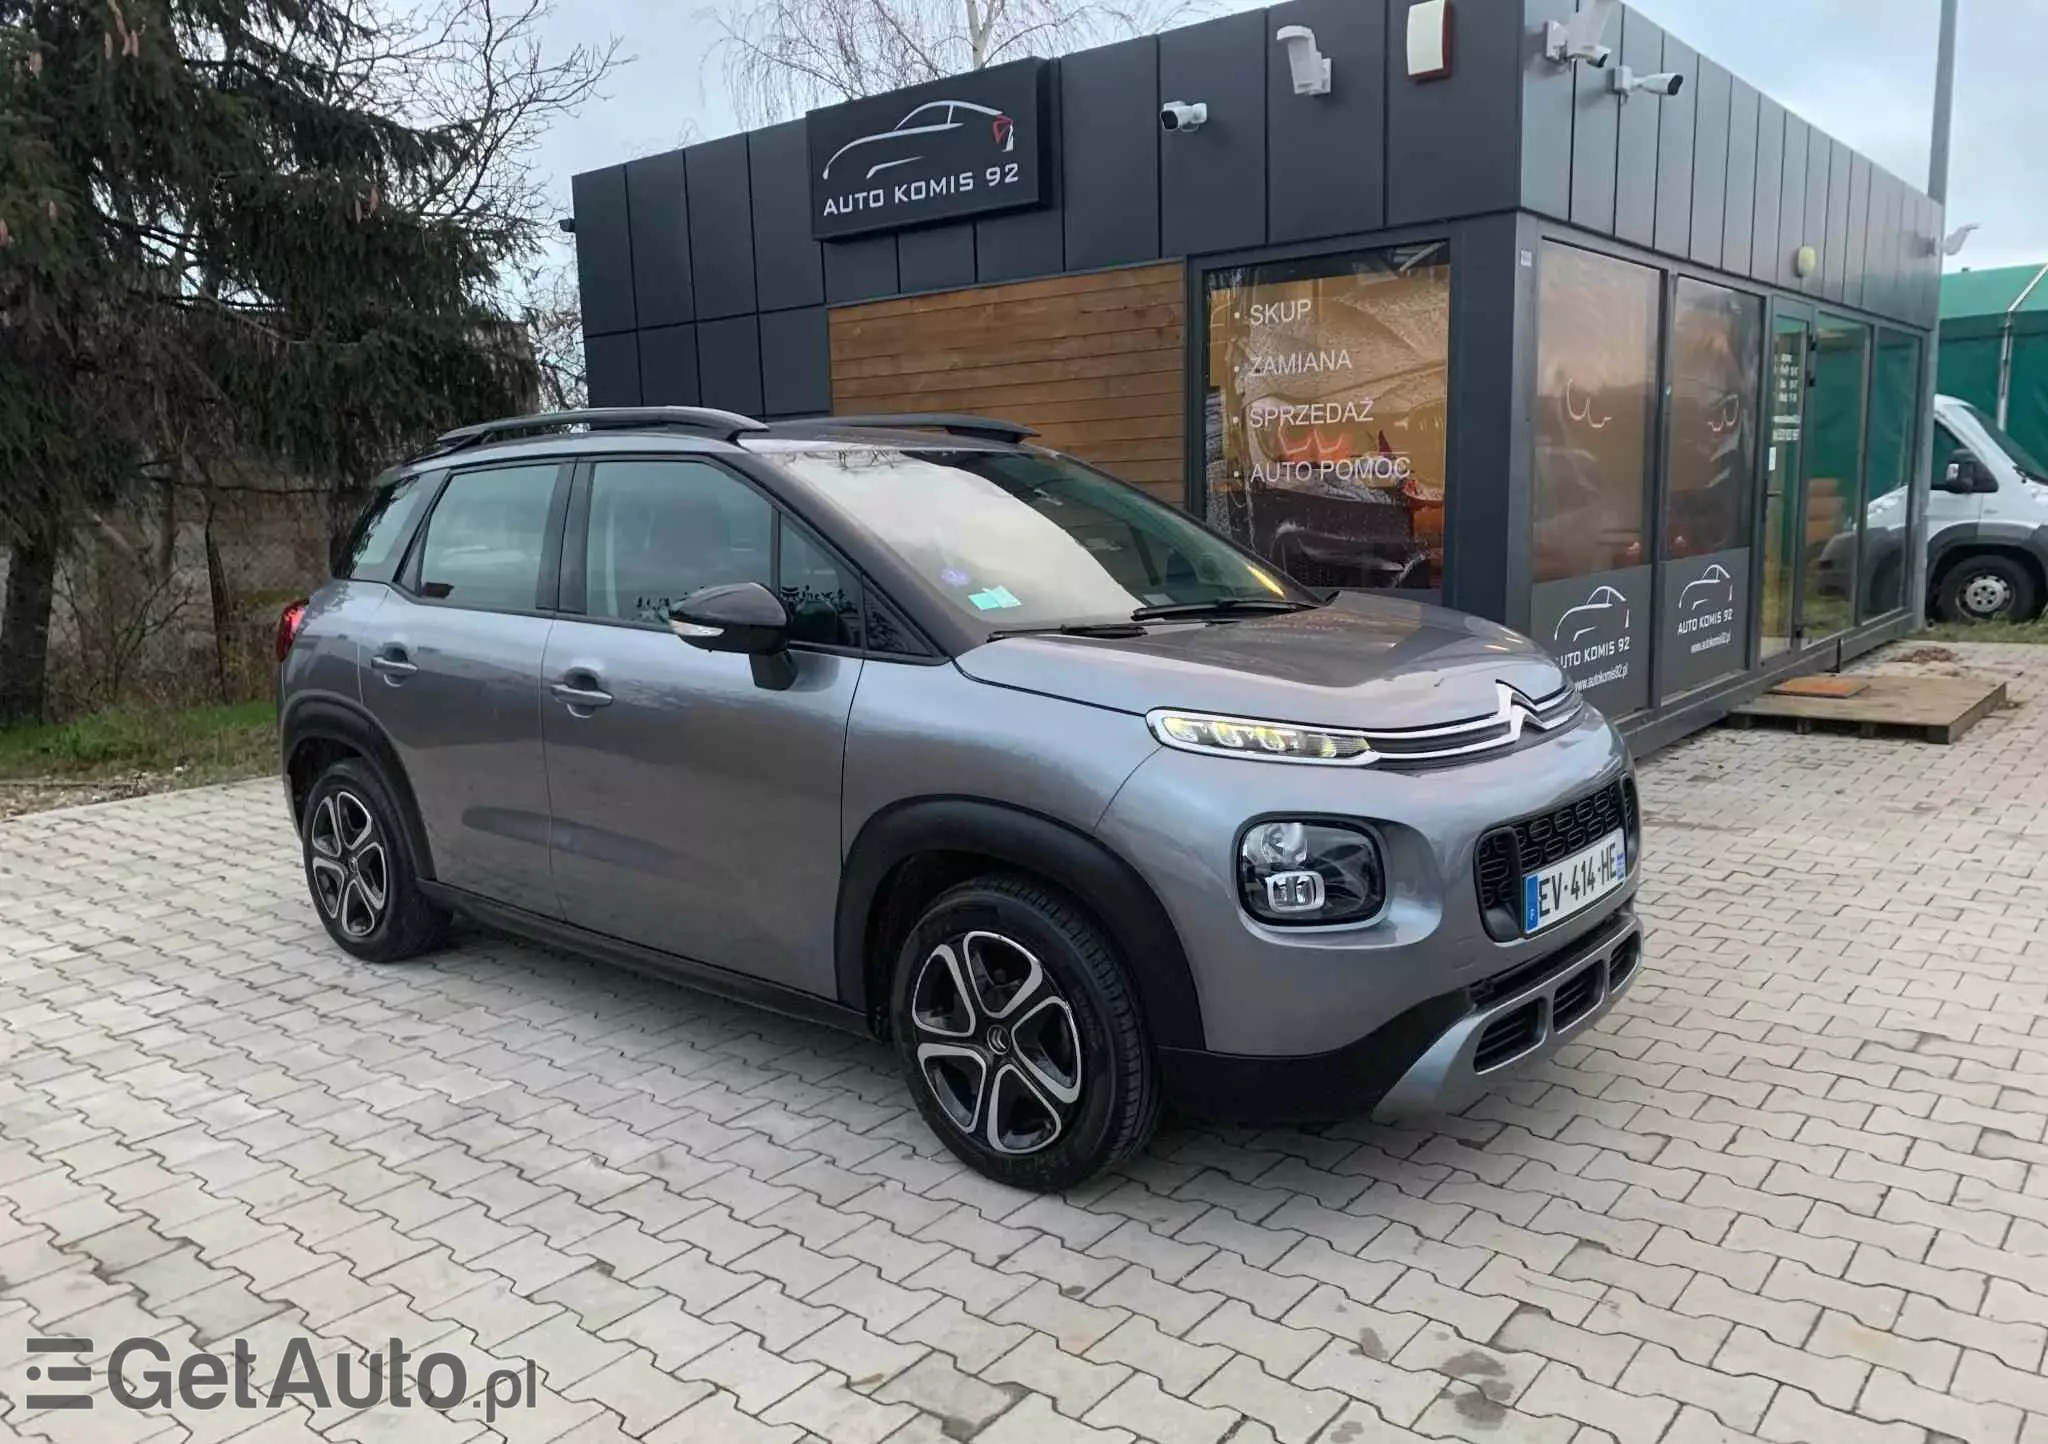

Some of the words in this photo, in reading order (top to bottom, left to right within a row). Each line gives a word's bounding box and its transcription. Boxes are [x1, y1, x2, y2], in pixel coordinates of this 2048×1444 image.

[824, 189, 884, 216] AUTO
[895, 172, 974, 204] KOMIS
[986, 163, 1019, 187] 92
[1250, 299, 1312, 326] SKUP
[1250, 349, 1352, 377] ZAMIANA
[1250, 397, 1374, 428] SPRZEDAŻ
[1250, 461, 1313, 483] AUTO
[1320, 457, 1411, 481] POMOC
[1678, 618, 1698, 635] AUTO
[1700, 611, 1721, 629] KOMIS
[1723, 608, 1733, 623] 92
[1556, 651, 1581, 669] UTO
[1584, 641, 1615, 662] KOMIS
[1618, 636, 1631, 653] 92
